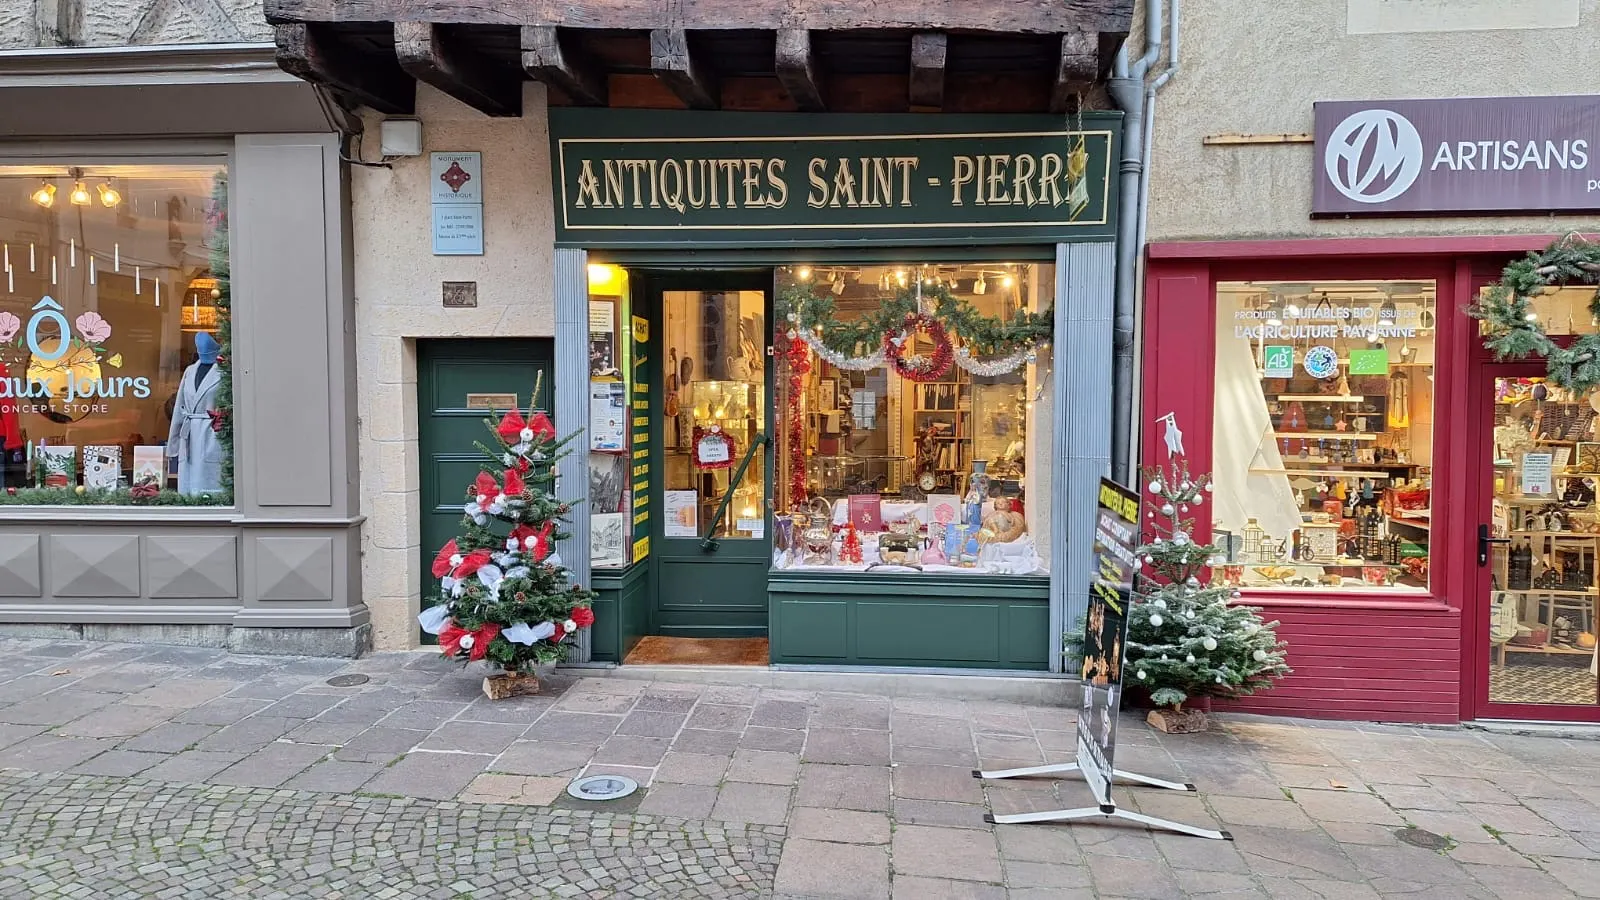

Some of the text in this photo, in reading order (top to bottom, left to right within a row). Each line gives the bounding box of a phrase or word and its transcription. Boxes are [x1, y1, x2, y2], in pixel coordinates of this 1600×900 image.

[1430, 140, 1588, 171] ARTISANS
[575, 157, 789, 214] ANTIQUITES
[807, 155, 919, 209] SAINT
[1234, 310, 1277, 319] PRODUITS
[1282, 305, 1350, 319] ÉQUITABLES
[1353, 307, 1374, 318] BIO
[26, 295, 71, 361] Ô
[1234, 324, 1416, 339] L'AGRICULTURE PAYSANNE
[1267, 353, 1289, 368] AB
[63, 404, 108, 413] STORE
